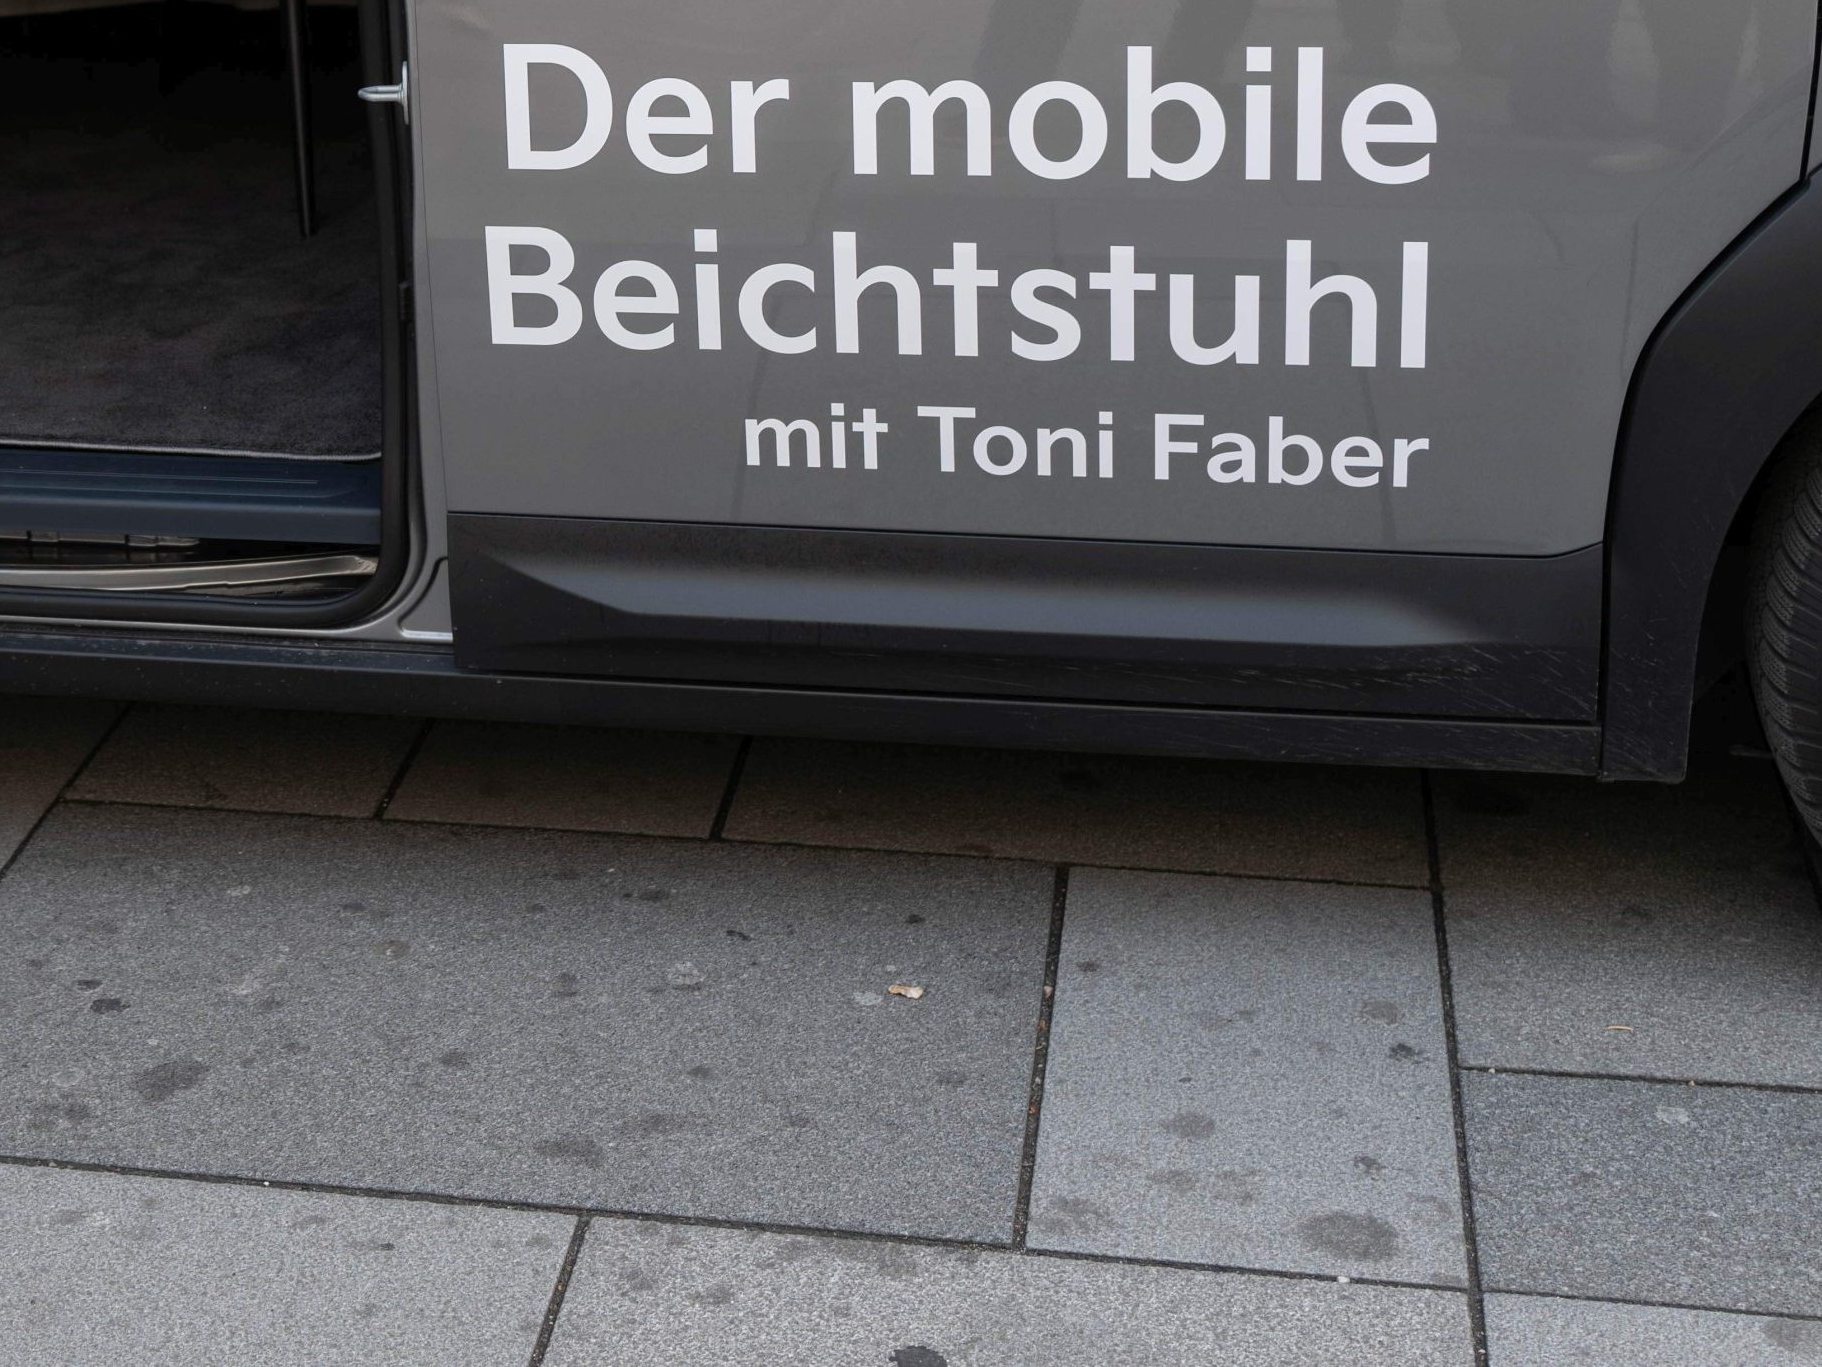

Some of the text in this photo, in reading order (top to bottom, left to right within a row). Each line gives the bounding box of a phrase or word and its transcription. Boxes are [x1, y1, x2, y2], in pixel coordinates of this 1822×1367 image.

[503, 43, 1438, 185] Der mobile
[484, 225, 1430, 369] Beichtstuhl
[744, 403, 1431, 488] mit Toni Faber
